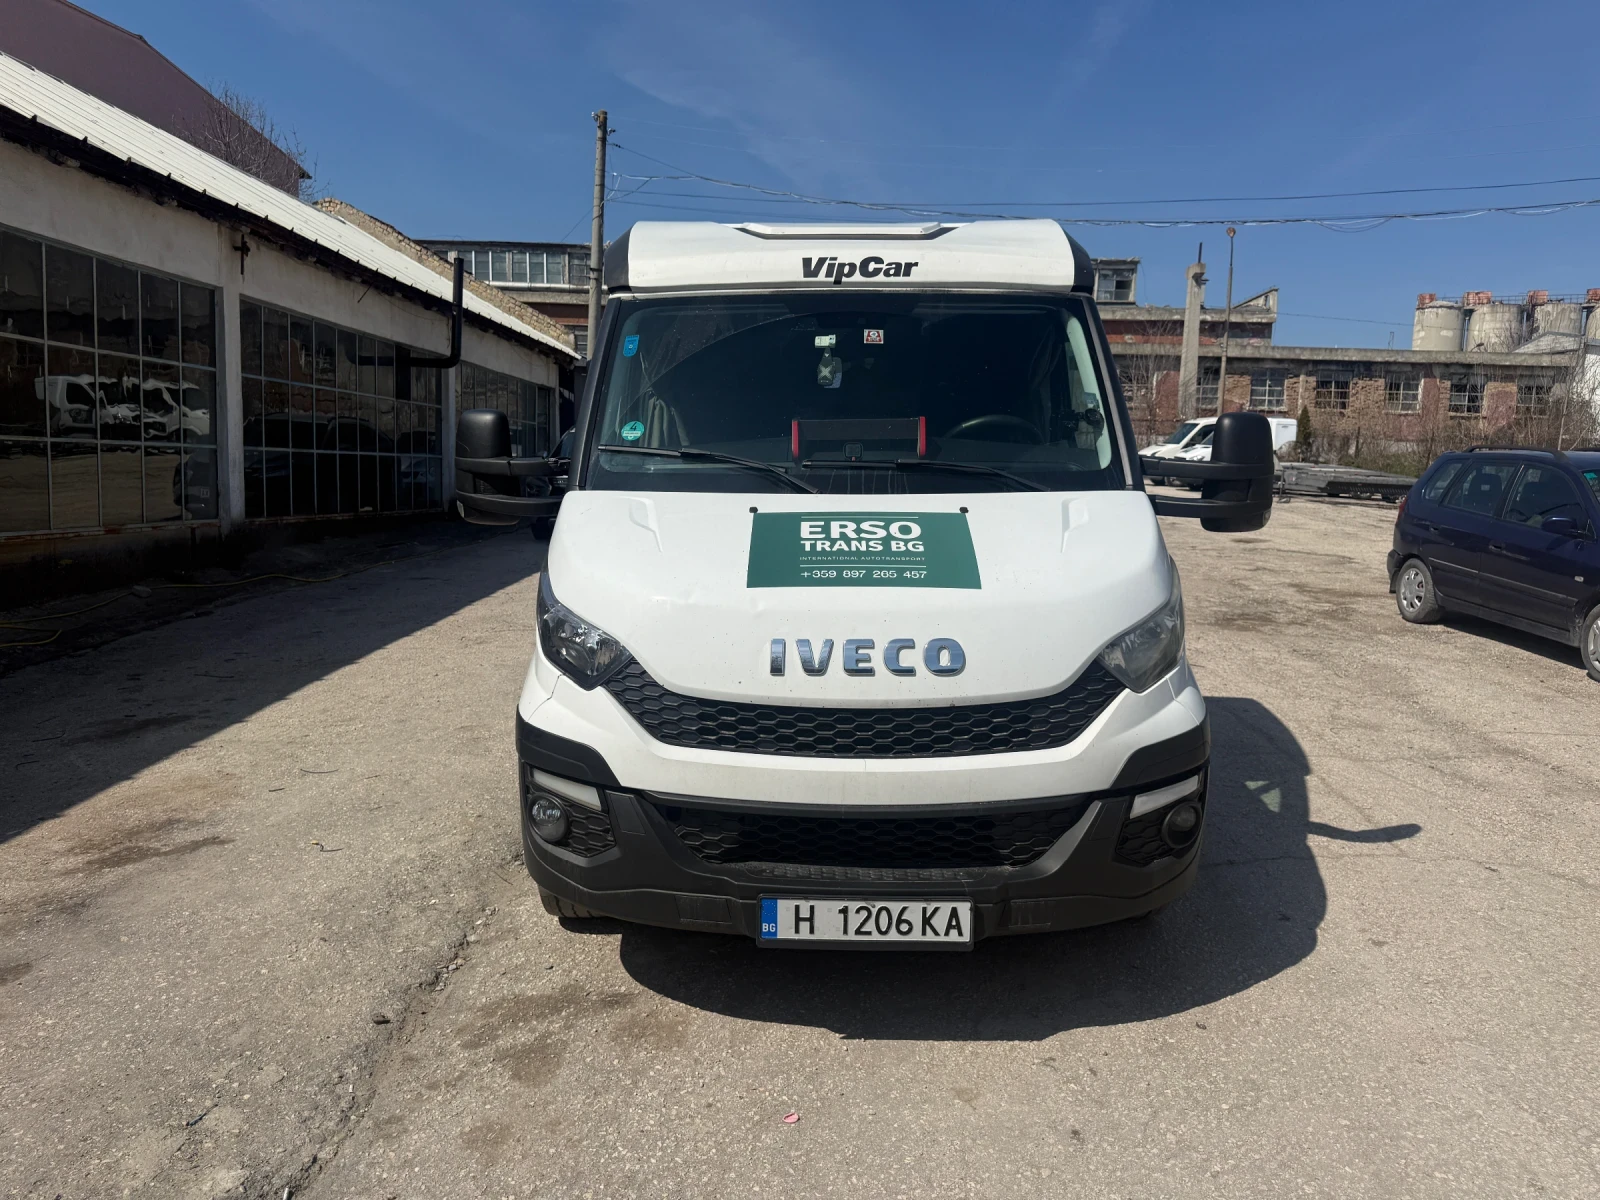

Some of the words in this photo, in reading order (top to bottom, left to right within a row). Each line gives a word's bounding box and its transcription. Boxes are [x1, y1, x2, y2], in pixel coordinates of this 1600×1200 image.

[802, 256, 919, 285] VipCar
[800, 521, 922, 539] ERSO
[800, 540, 883, 552] TRANS
[890, 540, 925, 552] BG
[800, 570, 837, 579] +359
[842, 570, 867, 579] 897
[903, 570, 928, 579] 457
[770, 638, 967, 677] IVECO
[762, 923, 776, 932] BG
